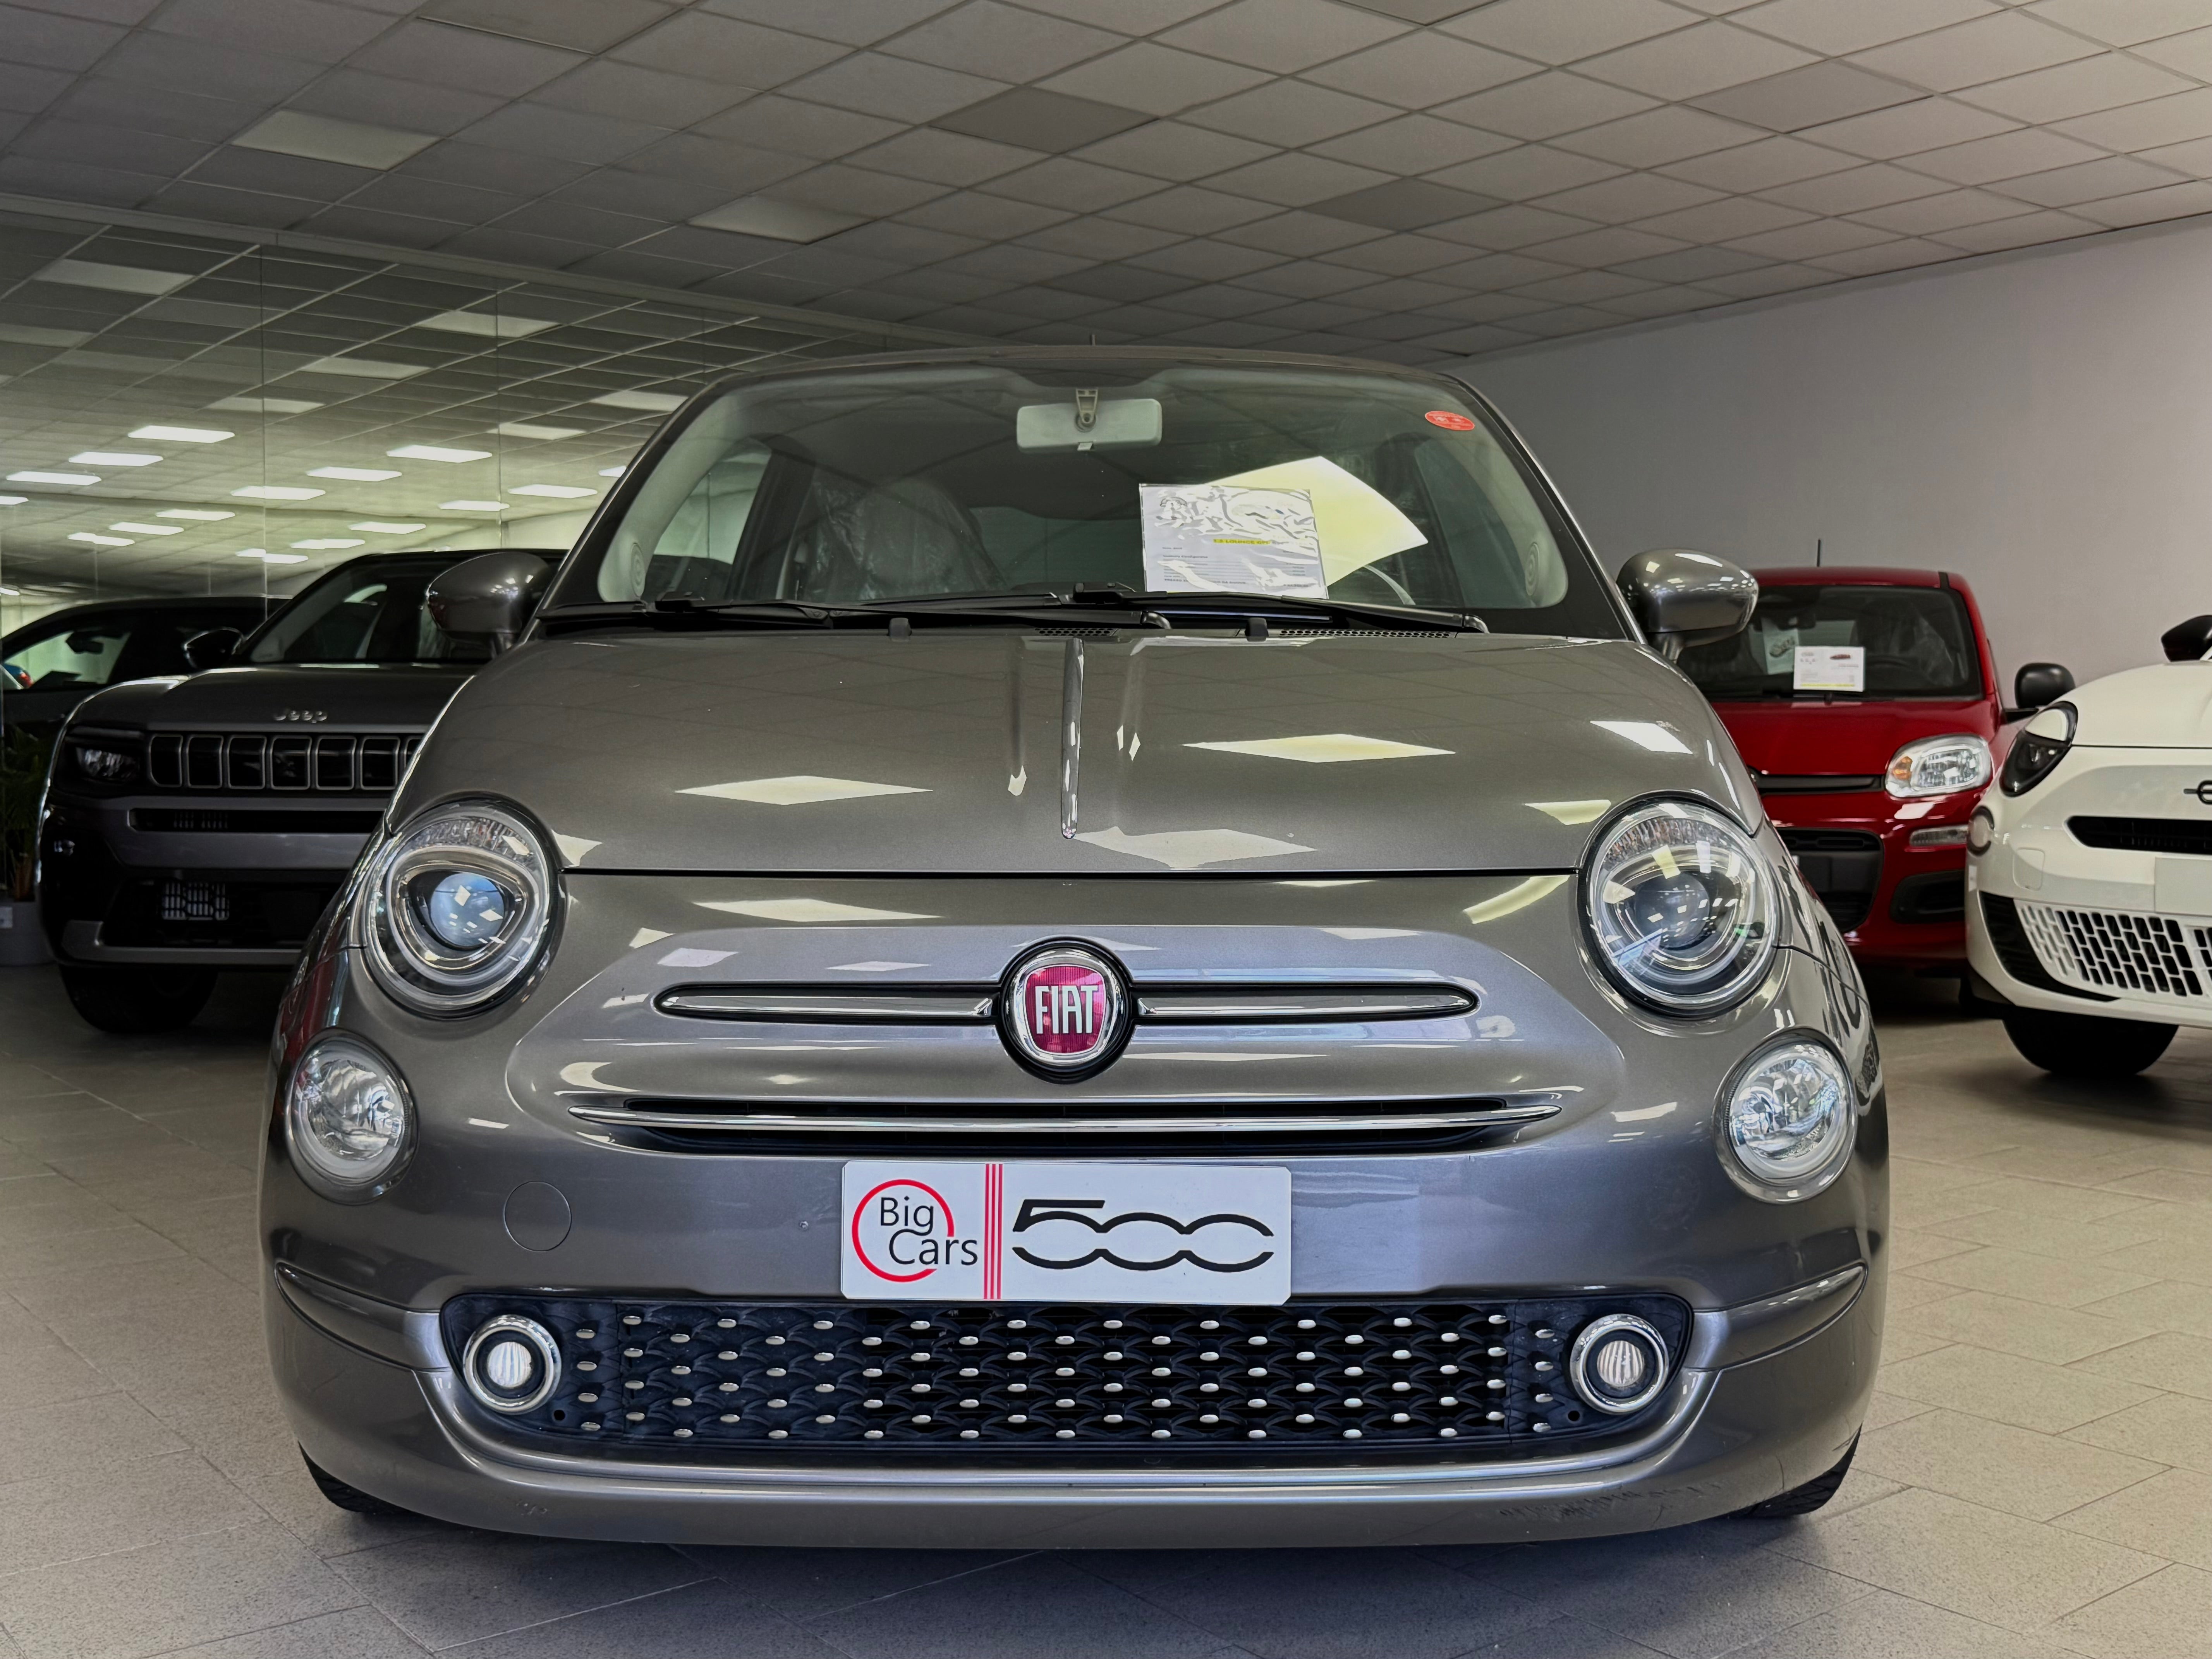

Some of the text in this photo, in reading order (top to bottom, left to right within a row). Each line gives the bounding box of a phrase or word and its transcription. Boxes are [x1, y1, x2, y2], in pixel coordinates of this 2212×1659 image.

[273, 708, 328, 724] Jeep
[1035, 985, 1098, 1034] FIAT
[880, 1196, 934, 1236] Big
[1012, 1199, 1274, 1273] 500
[888, 1228, 978, 1266] Cars
